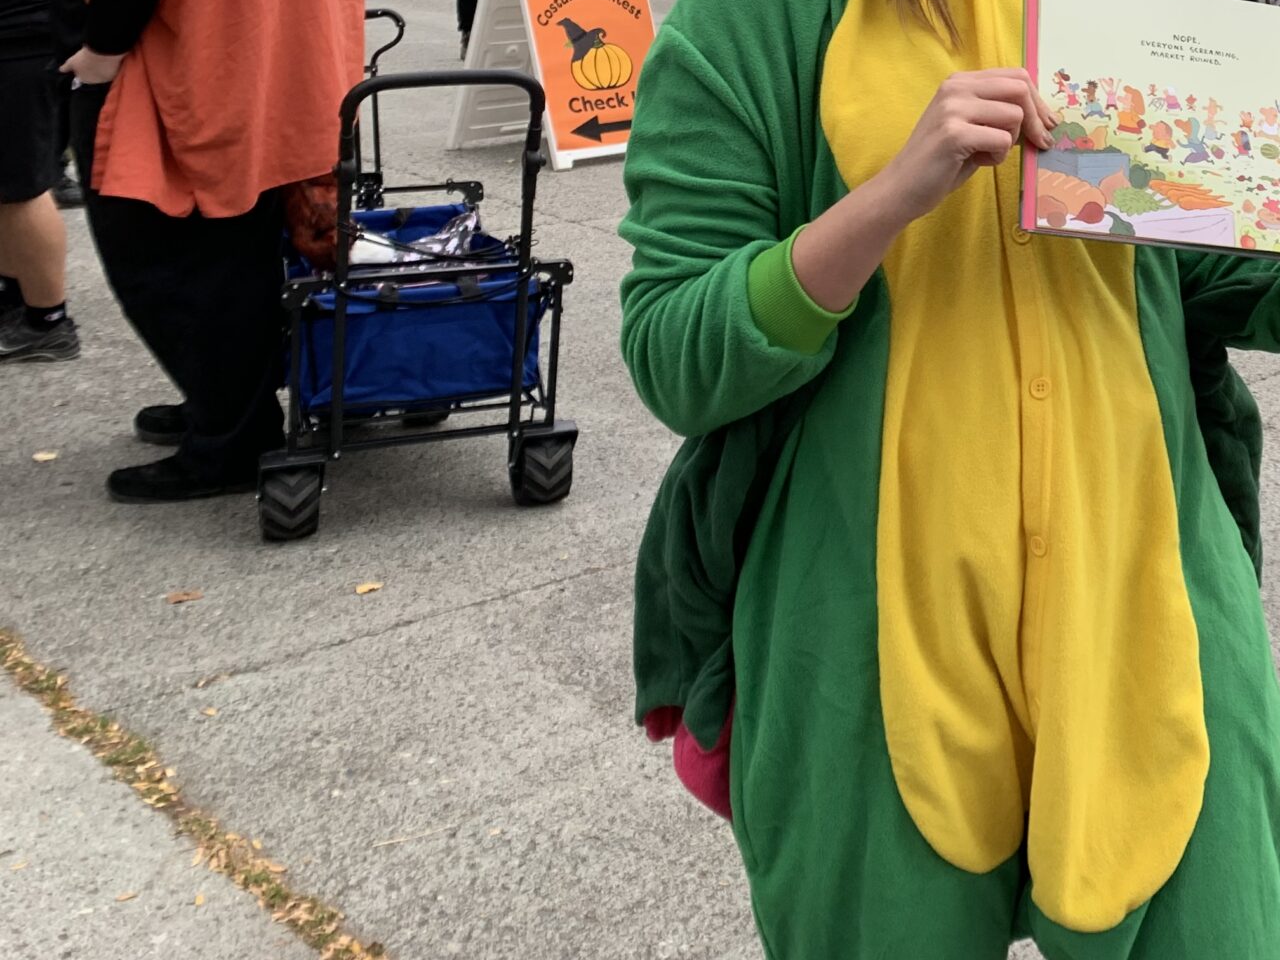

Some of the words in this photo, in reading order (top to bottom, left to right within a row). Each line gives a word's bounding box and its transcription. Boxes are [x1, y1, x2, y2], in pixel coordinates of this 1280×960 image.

[1172, 33, 1201, 45] NOPE.
[1140, 39, 1184, 52] EVERYONE
[1189, 46, 1240, 61] SCREAMING.
[1150, 50, 1185, 62] MARKET
[568, 92, 629, 113] Check
